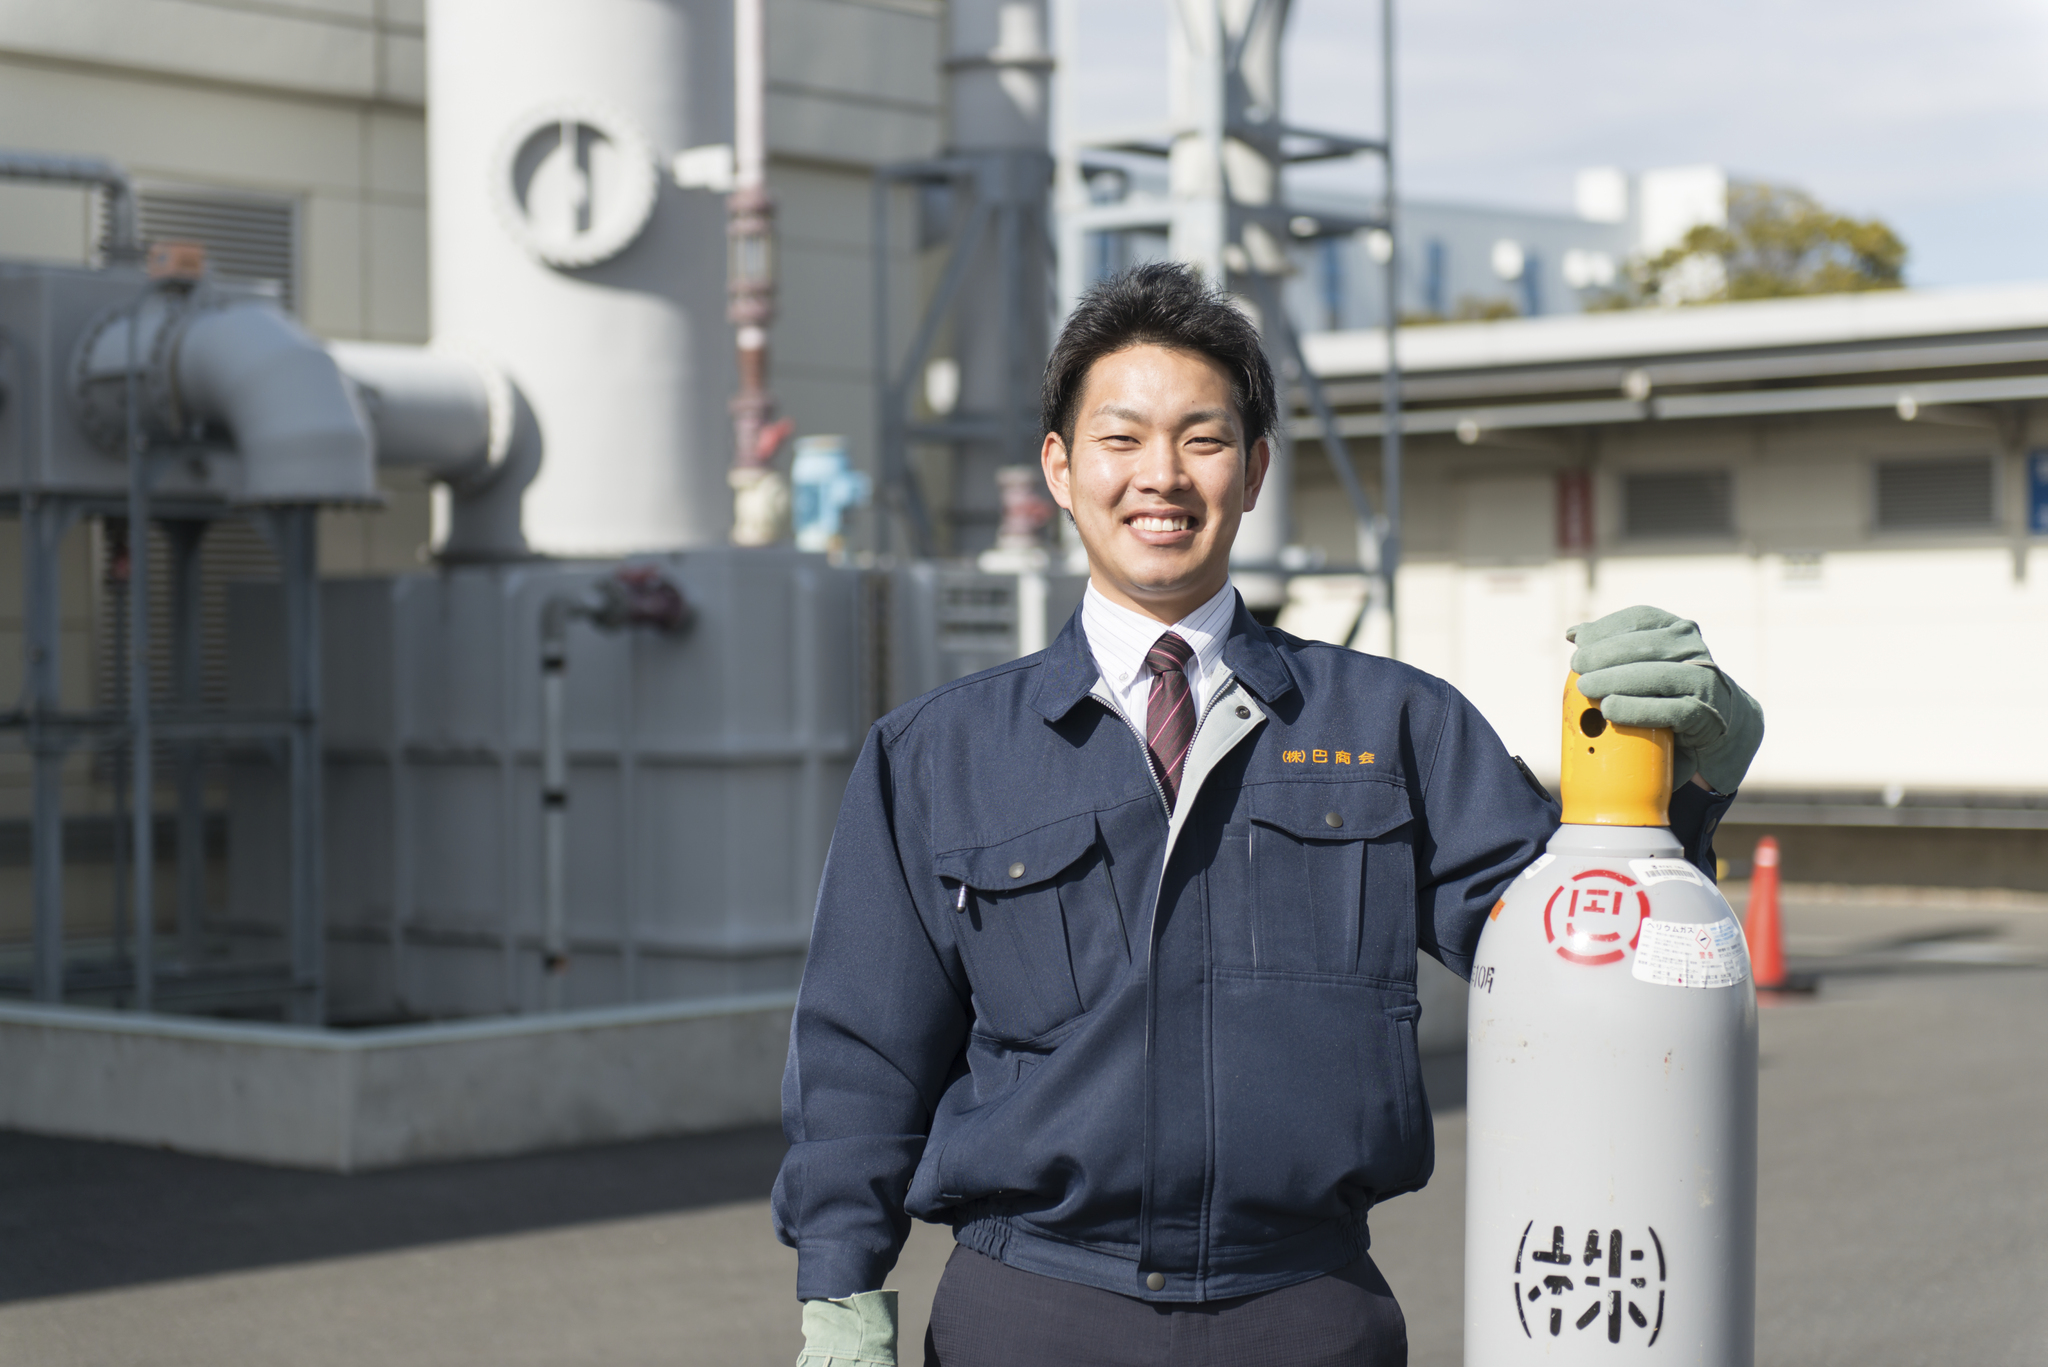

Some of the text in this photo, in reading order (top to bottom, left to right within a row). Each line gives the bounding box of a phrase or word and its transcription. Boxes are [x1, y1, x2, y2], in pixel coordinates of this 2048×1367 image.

[1647, 922, 1695, 934] ヘリウムガス
